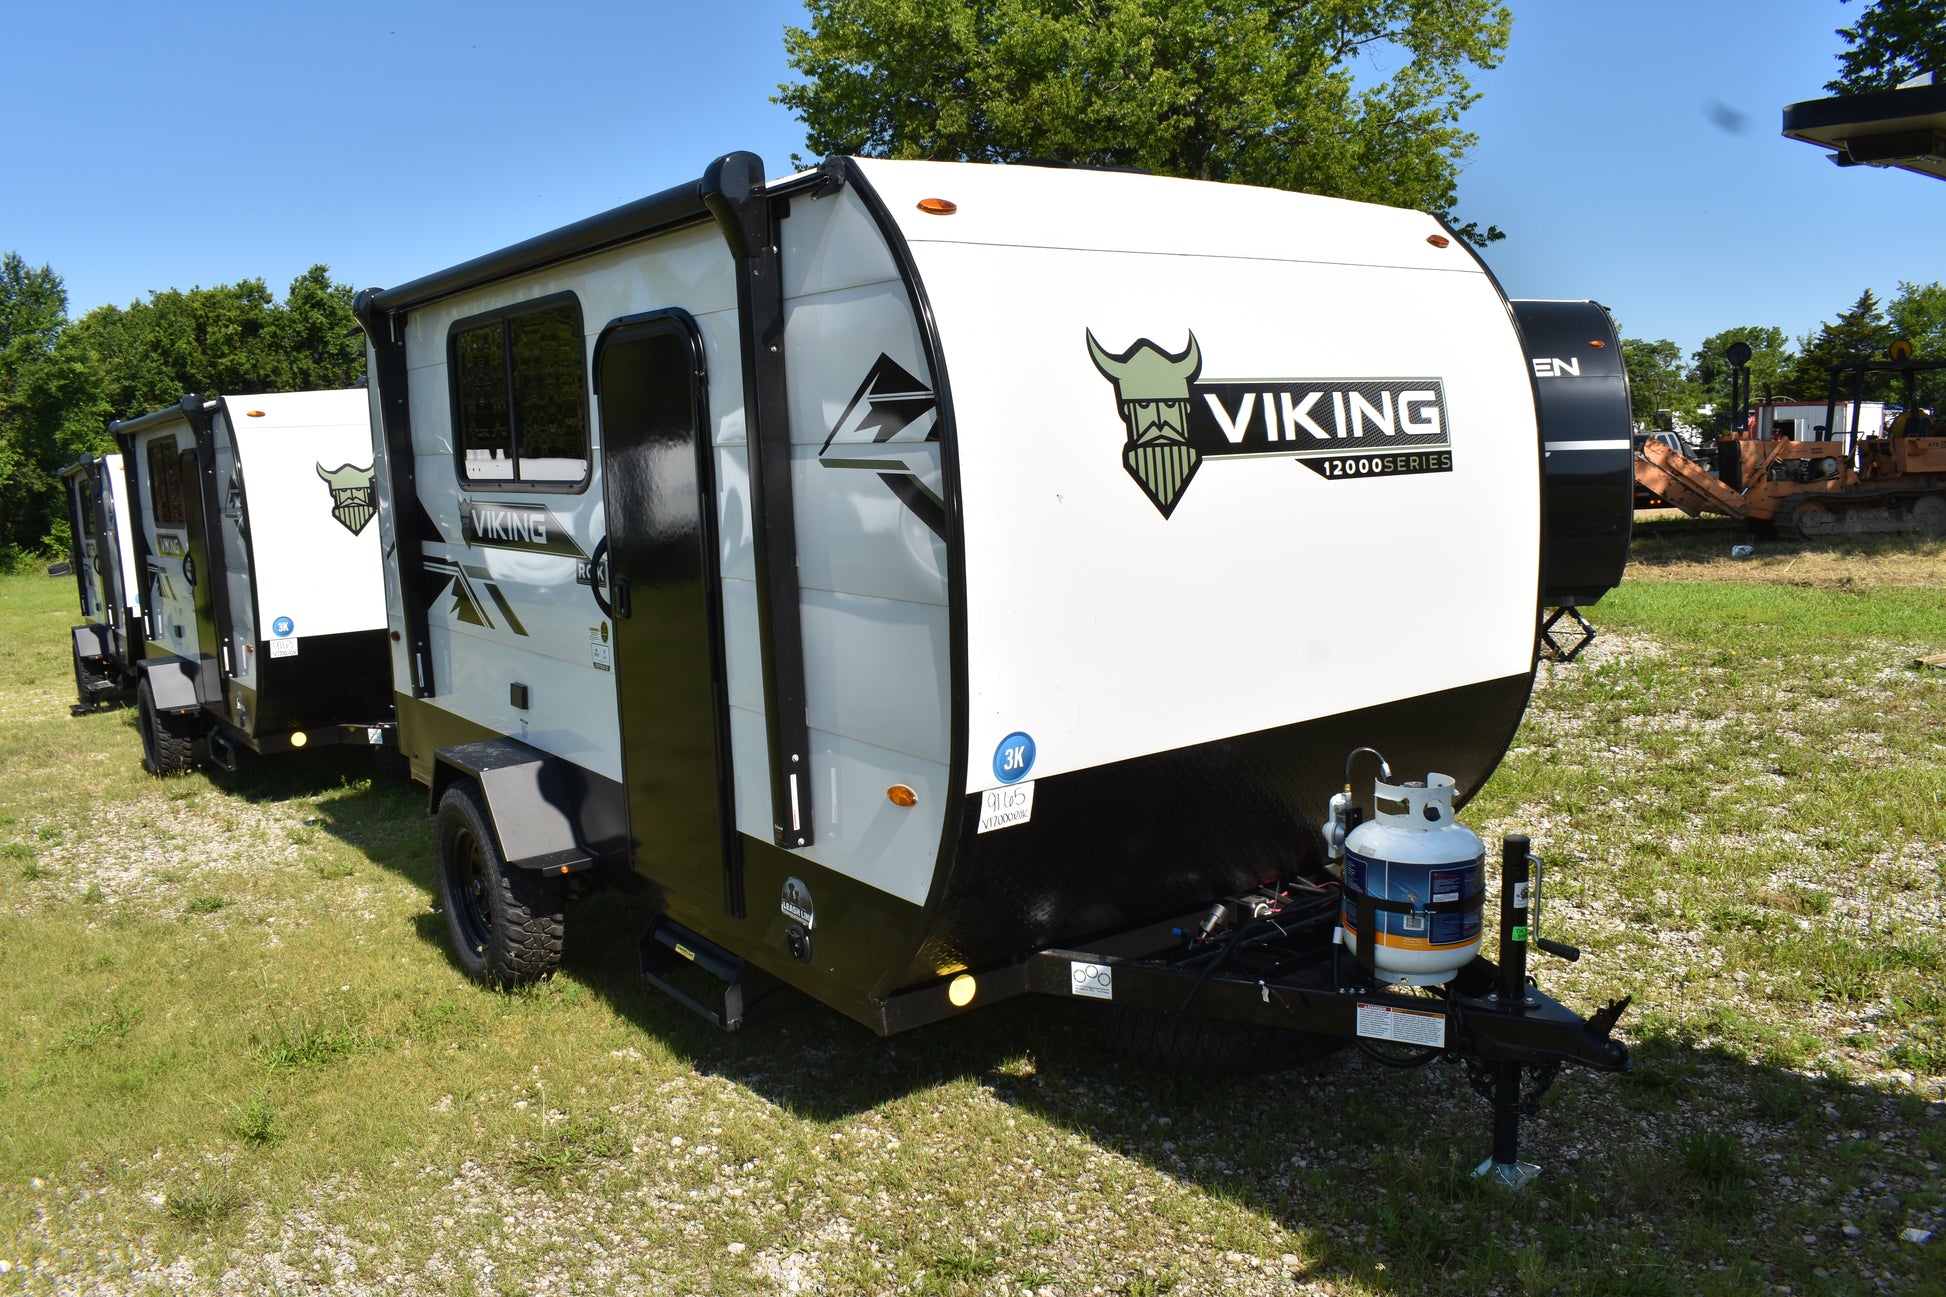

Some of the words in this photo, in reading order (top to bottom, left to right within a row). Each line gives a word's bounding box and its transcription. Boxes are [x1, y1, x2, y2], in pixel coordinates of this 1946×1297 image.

[1204, 390, 1441, 443] VIKING
[472, 509, 547, 544] VIKING
[277, 622, 289, 632] 3K
[1004, 747, 1025, 770] 3K
[987, 786, 1026, 812] 9165
